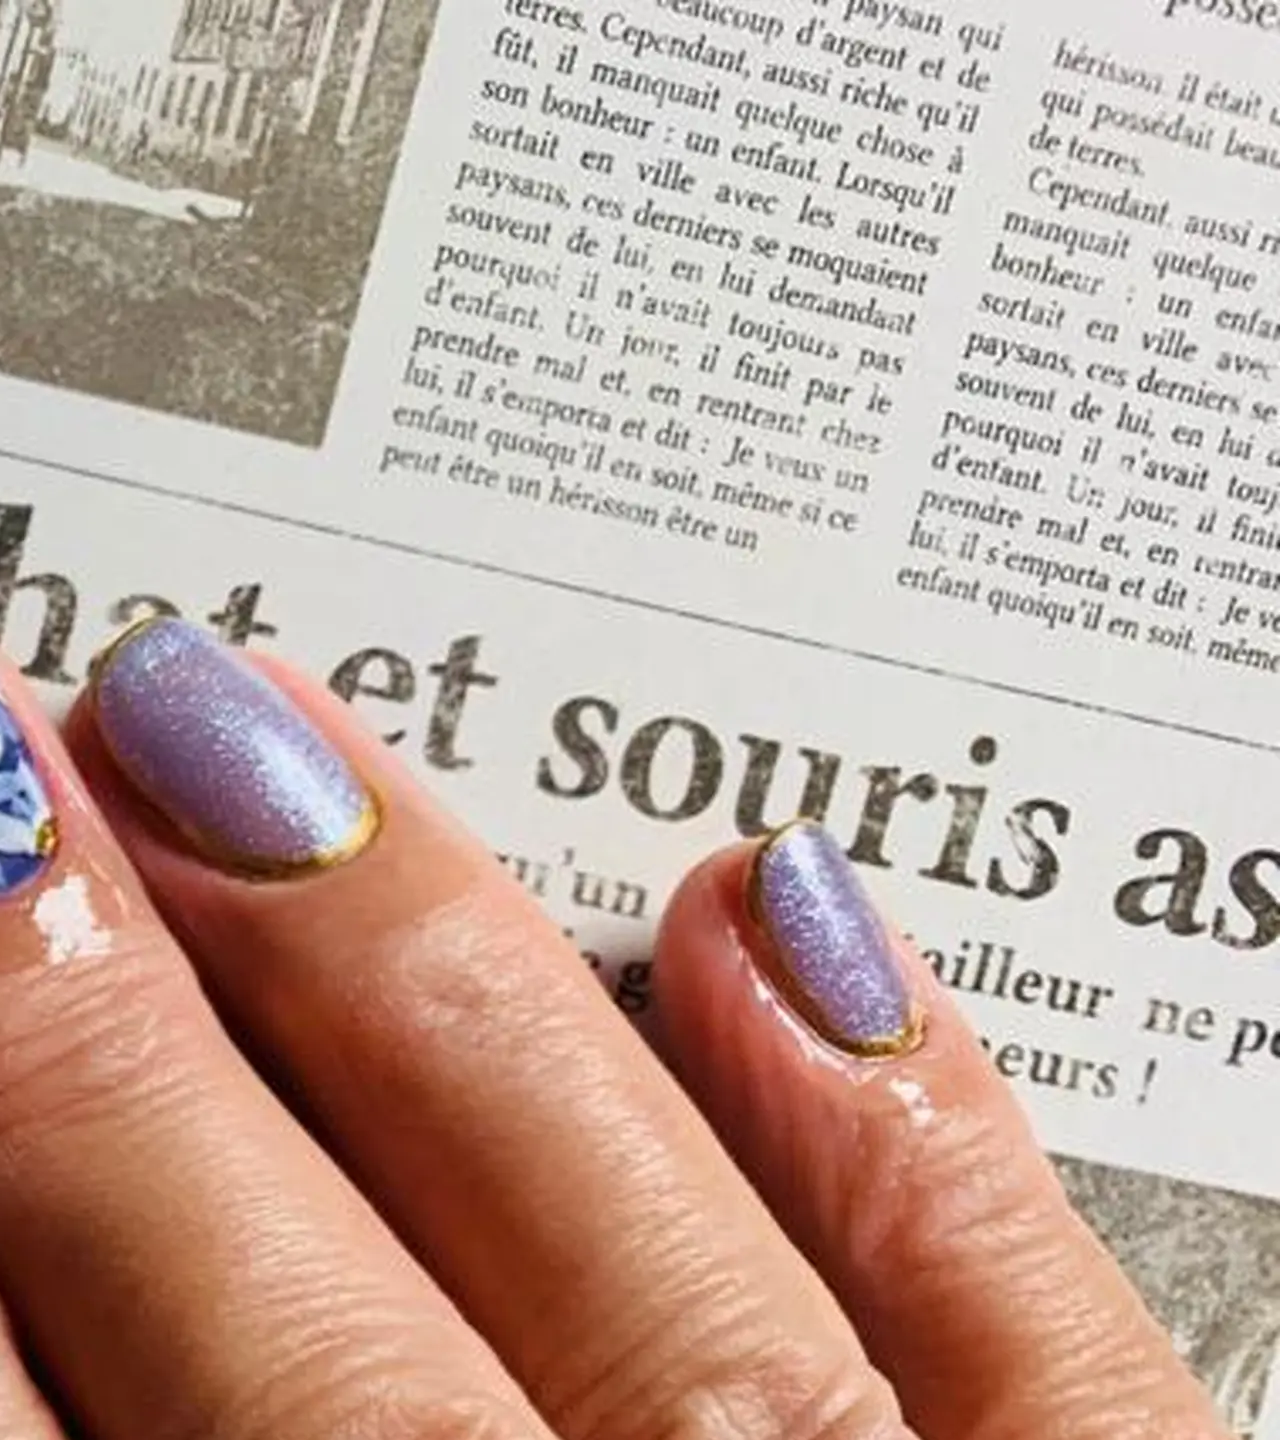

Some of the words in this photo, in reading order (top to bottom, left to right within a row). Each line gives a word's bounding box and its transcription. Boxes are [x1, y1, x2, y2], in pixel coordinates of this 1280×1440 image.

[600, 10, 751, 79] Cependant,
[761, 57, 831, 97] aussi
[840, 79, 908, 116] riche
[916, 100, 979, 133] qu'il
[796, 21, 907, 70] d'argent
[919, 57, 944, 79] et
[958, 59, 991, 92] de
[481, 77, 529, 107] son
[540, 82, 653, 140] bonheur
[684, 130, 719, 157] un
[732, 140, 822, 184] enfant.
[836, 161, 956, 216] Lorsqu'il
[556, 46, 577, 74] il
[590, 59, 720, 113] manquait
[735, 100, 842, 144] quelque
[856, 125, 935, 165] chose
[948, 148, 963, 173] à
[446, 202, 551, 246] souvent
[567, 230, 600, 258] de
[455, 161, 572, 211] paysans,
[582, 192, 624, 221] ces
[635, 202, 742, 250] derniers
[751, 235, 779, 258] se
[787, 243, 928, 295] moquaient
[470, 117, 560, 161] sortait
[580, 149, 614, 174] en
[638, 160, 696, 195] ville
[715, 185, 780, 215] avec
[799, 195, 835, 227] les
[856, 214, 941, 257] autres
[955, 371, 1056, 412] souvent
[1070, 394, 1103, 422] de
[1171, 425, 1204, 447] en
[1218, 430, 1252, 460] lui
[963, 332, 1076, 379] paysans,
[1086, 363, 1126, 387] ces
[1137, 369, 1240, 414] derniers
[1252, 400, 1277, 422] se
[941, 410, 1063, 457] pourquoi
[1081, 436, 1103, 464] il
[380, 444, 442, 474] peut
[447, 455, 500, 488] être
[508, 475, 542, 500] un
[549, 479, 660, 529] hérisson
[665, 508, 719, 541] être
[725, 525, 759, 551] un
[897, 567, 981, 603] enfant
[986, 587, 1103, 632] quoiqu'il
[1108, 617, 1139, 641] en
[985, 541, 1110, 593] s'emporta
[1120, 578, 1144, 599] et
[1153, 582, 1187, 612] dit
[327, 635, 500, 770] et
[537, 695, 1071, 902] souris
[495, 847, 646, 919] u'un
[903, 933, 1114, 1019] ailleur
[1142, 995, 1214, 1042] ne
[1138, 1056, 1158, 1103] !
